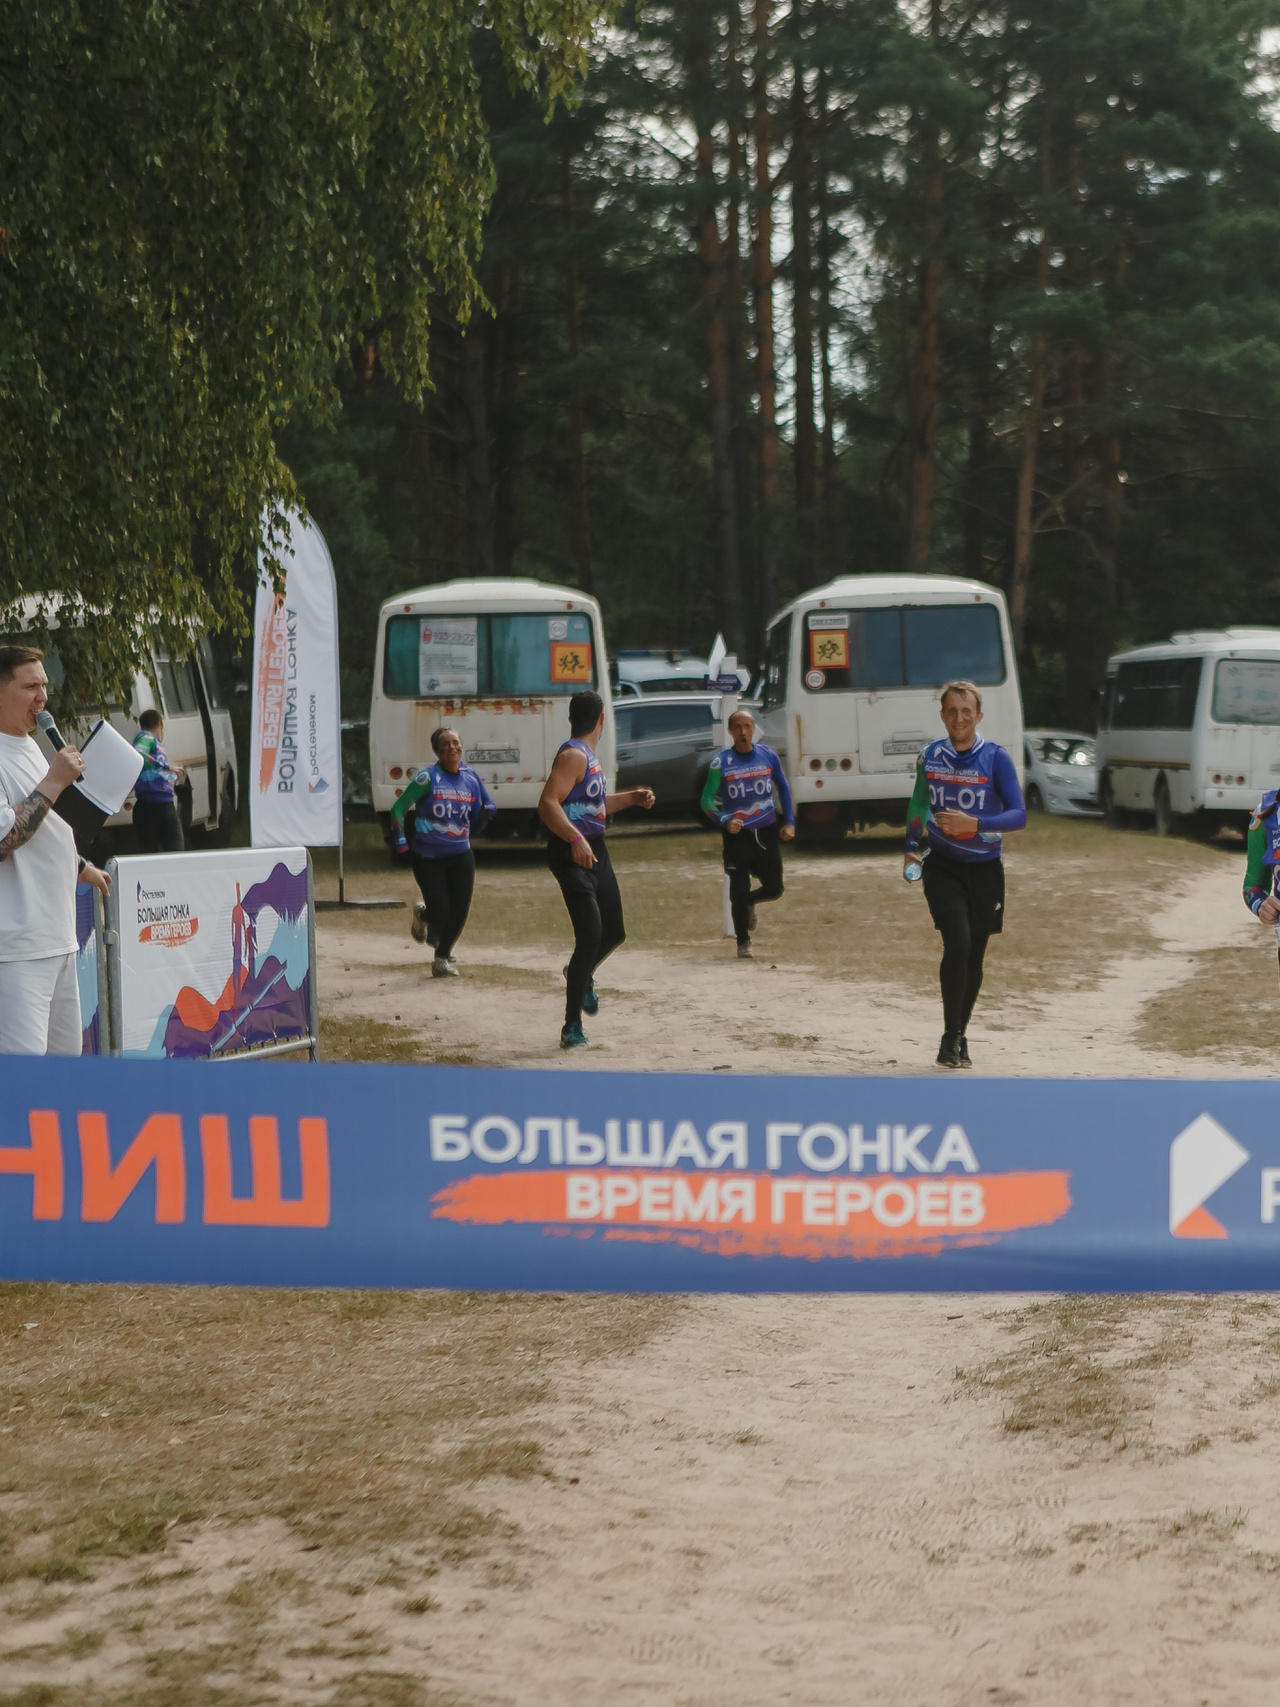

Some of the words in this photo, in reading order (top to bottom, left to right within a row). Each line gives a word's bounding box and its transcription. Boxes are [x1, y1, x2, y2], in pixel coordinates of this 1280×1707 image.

[728, 778, 772, 800] 01-06
[928, 784, 986, 810] 01-01
[137, 905, 169, 924] БОЛЬШАЯ
[169, 904, 190, 921] ГОНКА
[429, 1115, 748, 1169] БОЛЬШАЯ
[765, 1123, 980, 1173] ГОНКА
[565, 1176, 757, 1224] ВРЕМЯ
[771, 1179, 986, 1227] ГЕРОЕВ
